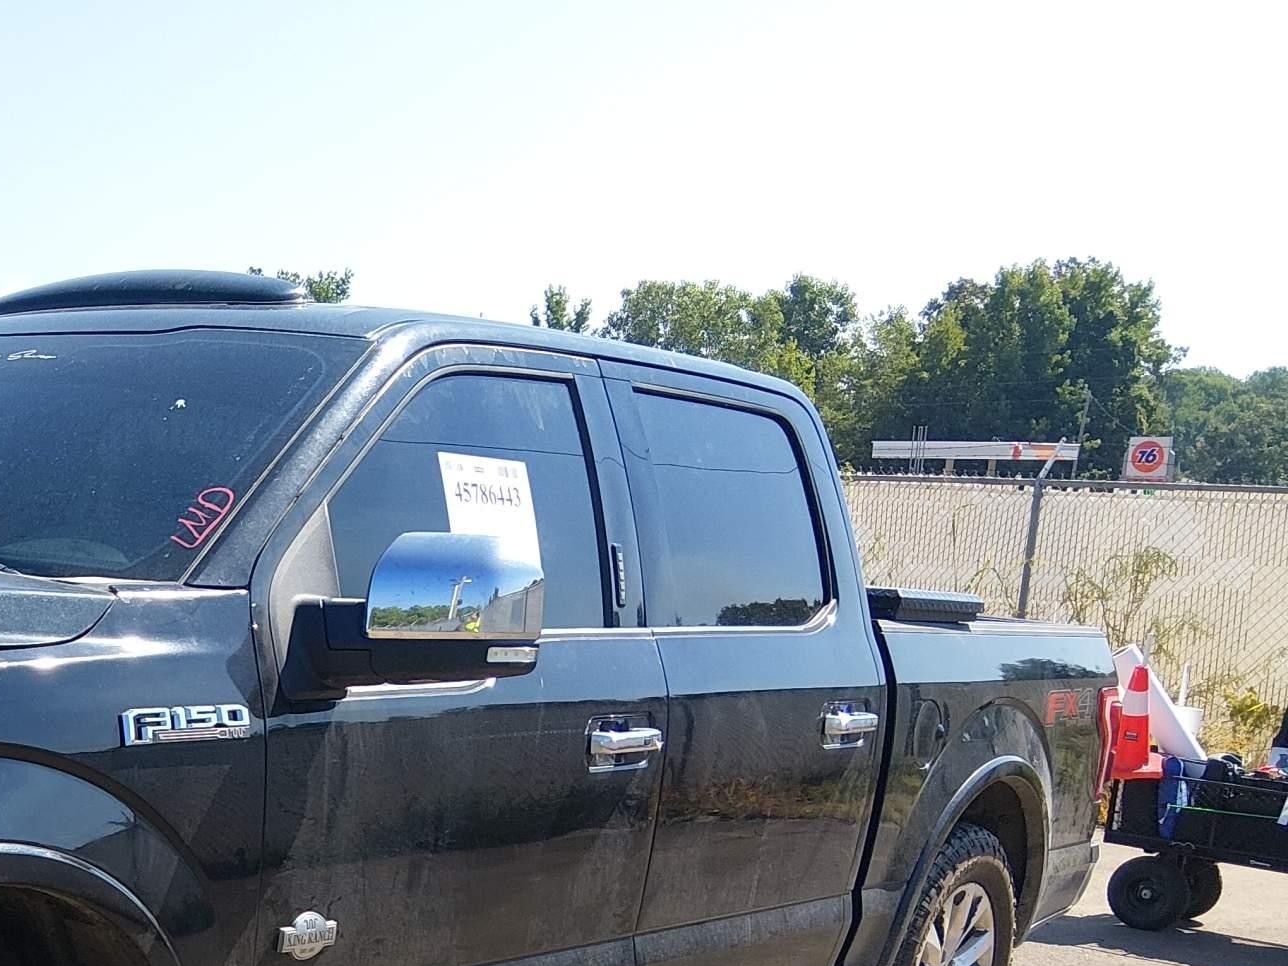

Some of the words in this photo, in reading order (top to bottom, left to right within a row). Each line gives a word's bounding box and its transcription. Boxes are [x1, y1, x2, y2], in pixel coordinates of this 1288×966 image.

[1135, 447, 1159, 465] 76
[455, 481, 521, 508] 45786443
[1043, 687, 1094, 728] FX4
[118, 704, 250, 746] F150
